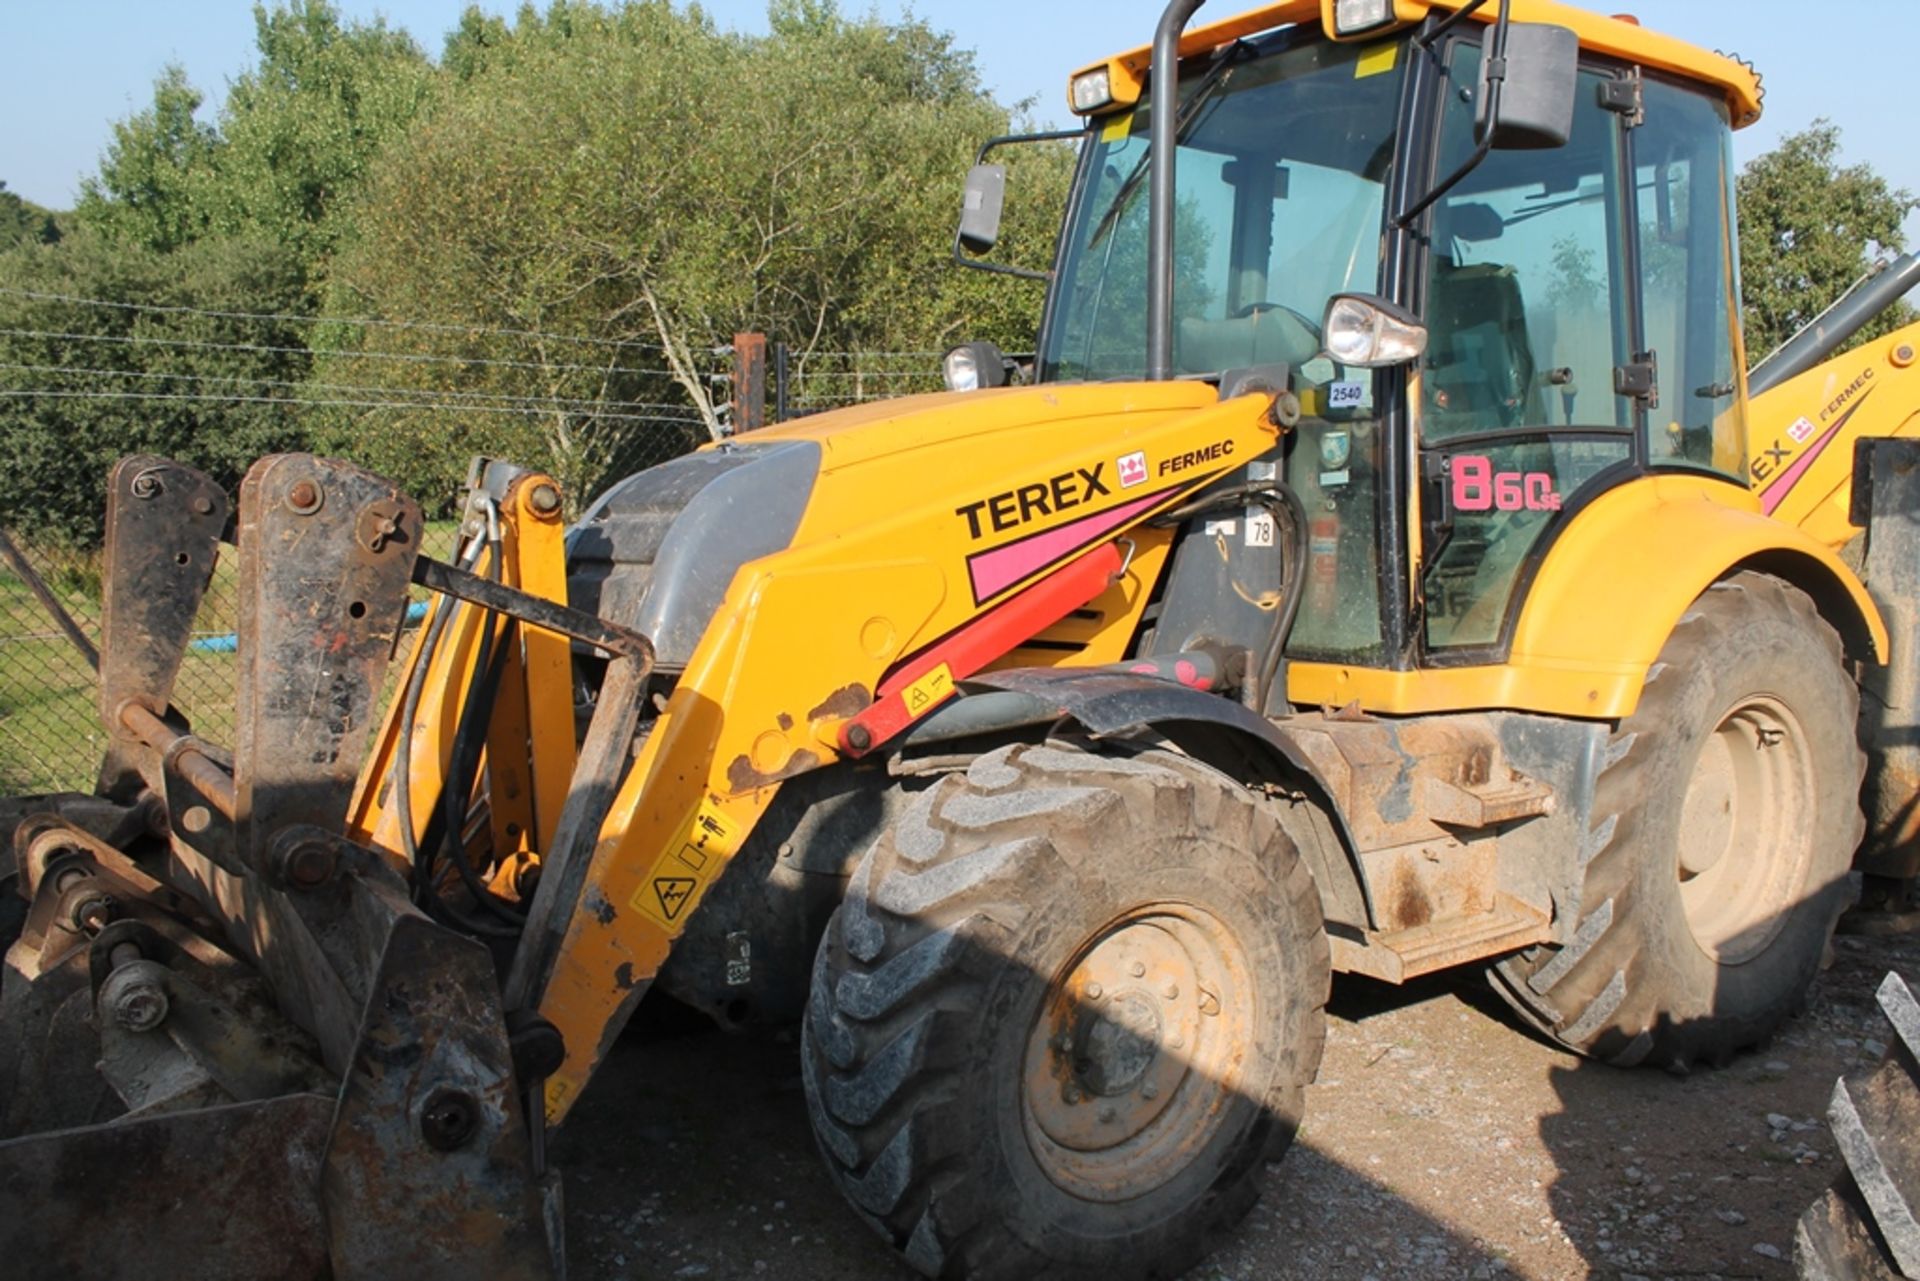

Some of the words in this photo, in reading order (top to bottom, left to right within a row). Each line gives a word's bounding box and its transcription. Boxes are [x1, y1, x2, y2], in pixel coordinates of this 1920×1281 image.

[1333, 386, 1362, 401] 2540
[1750, 439, 1792, 489] EX
[1820, 366, 1875, 421] FERMEC
[956, 462, 1111, 540] TEREX
[1158, 439, 1234, 477] FERMEC
[1254, 522, 1270, 542] 78
